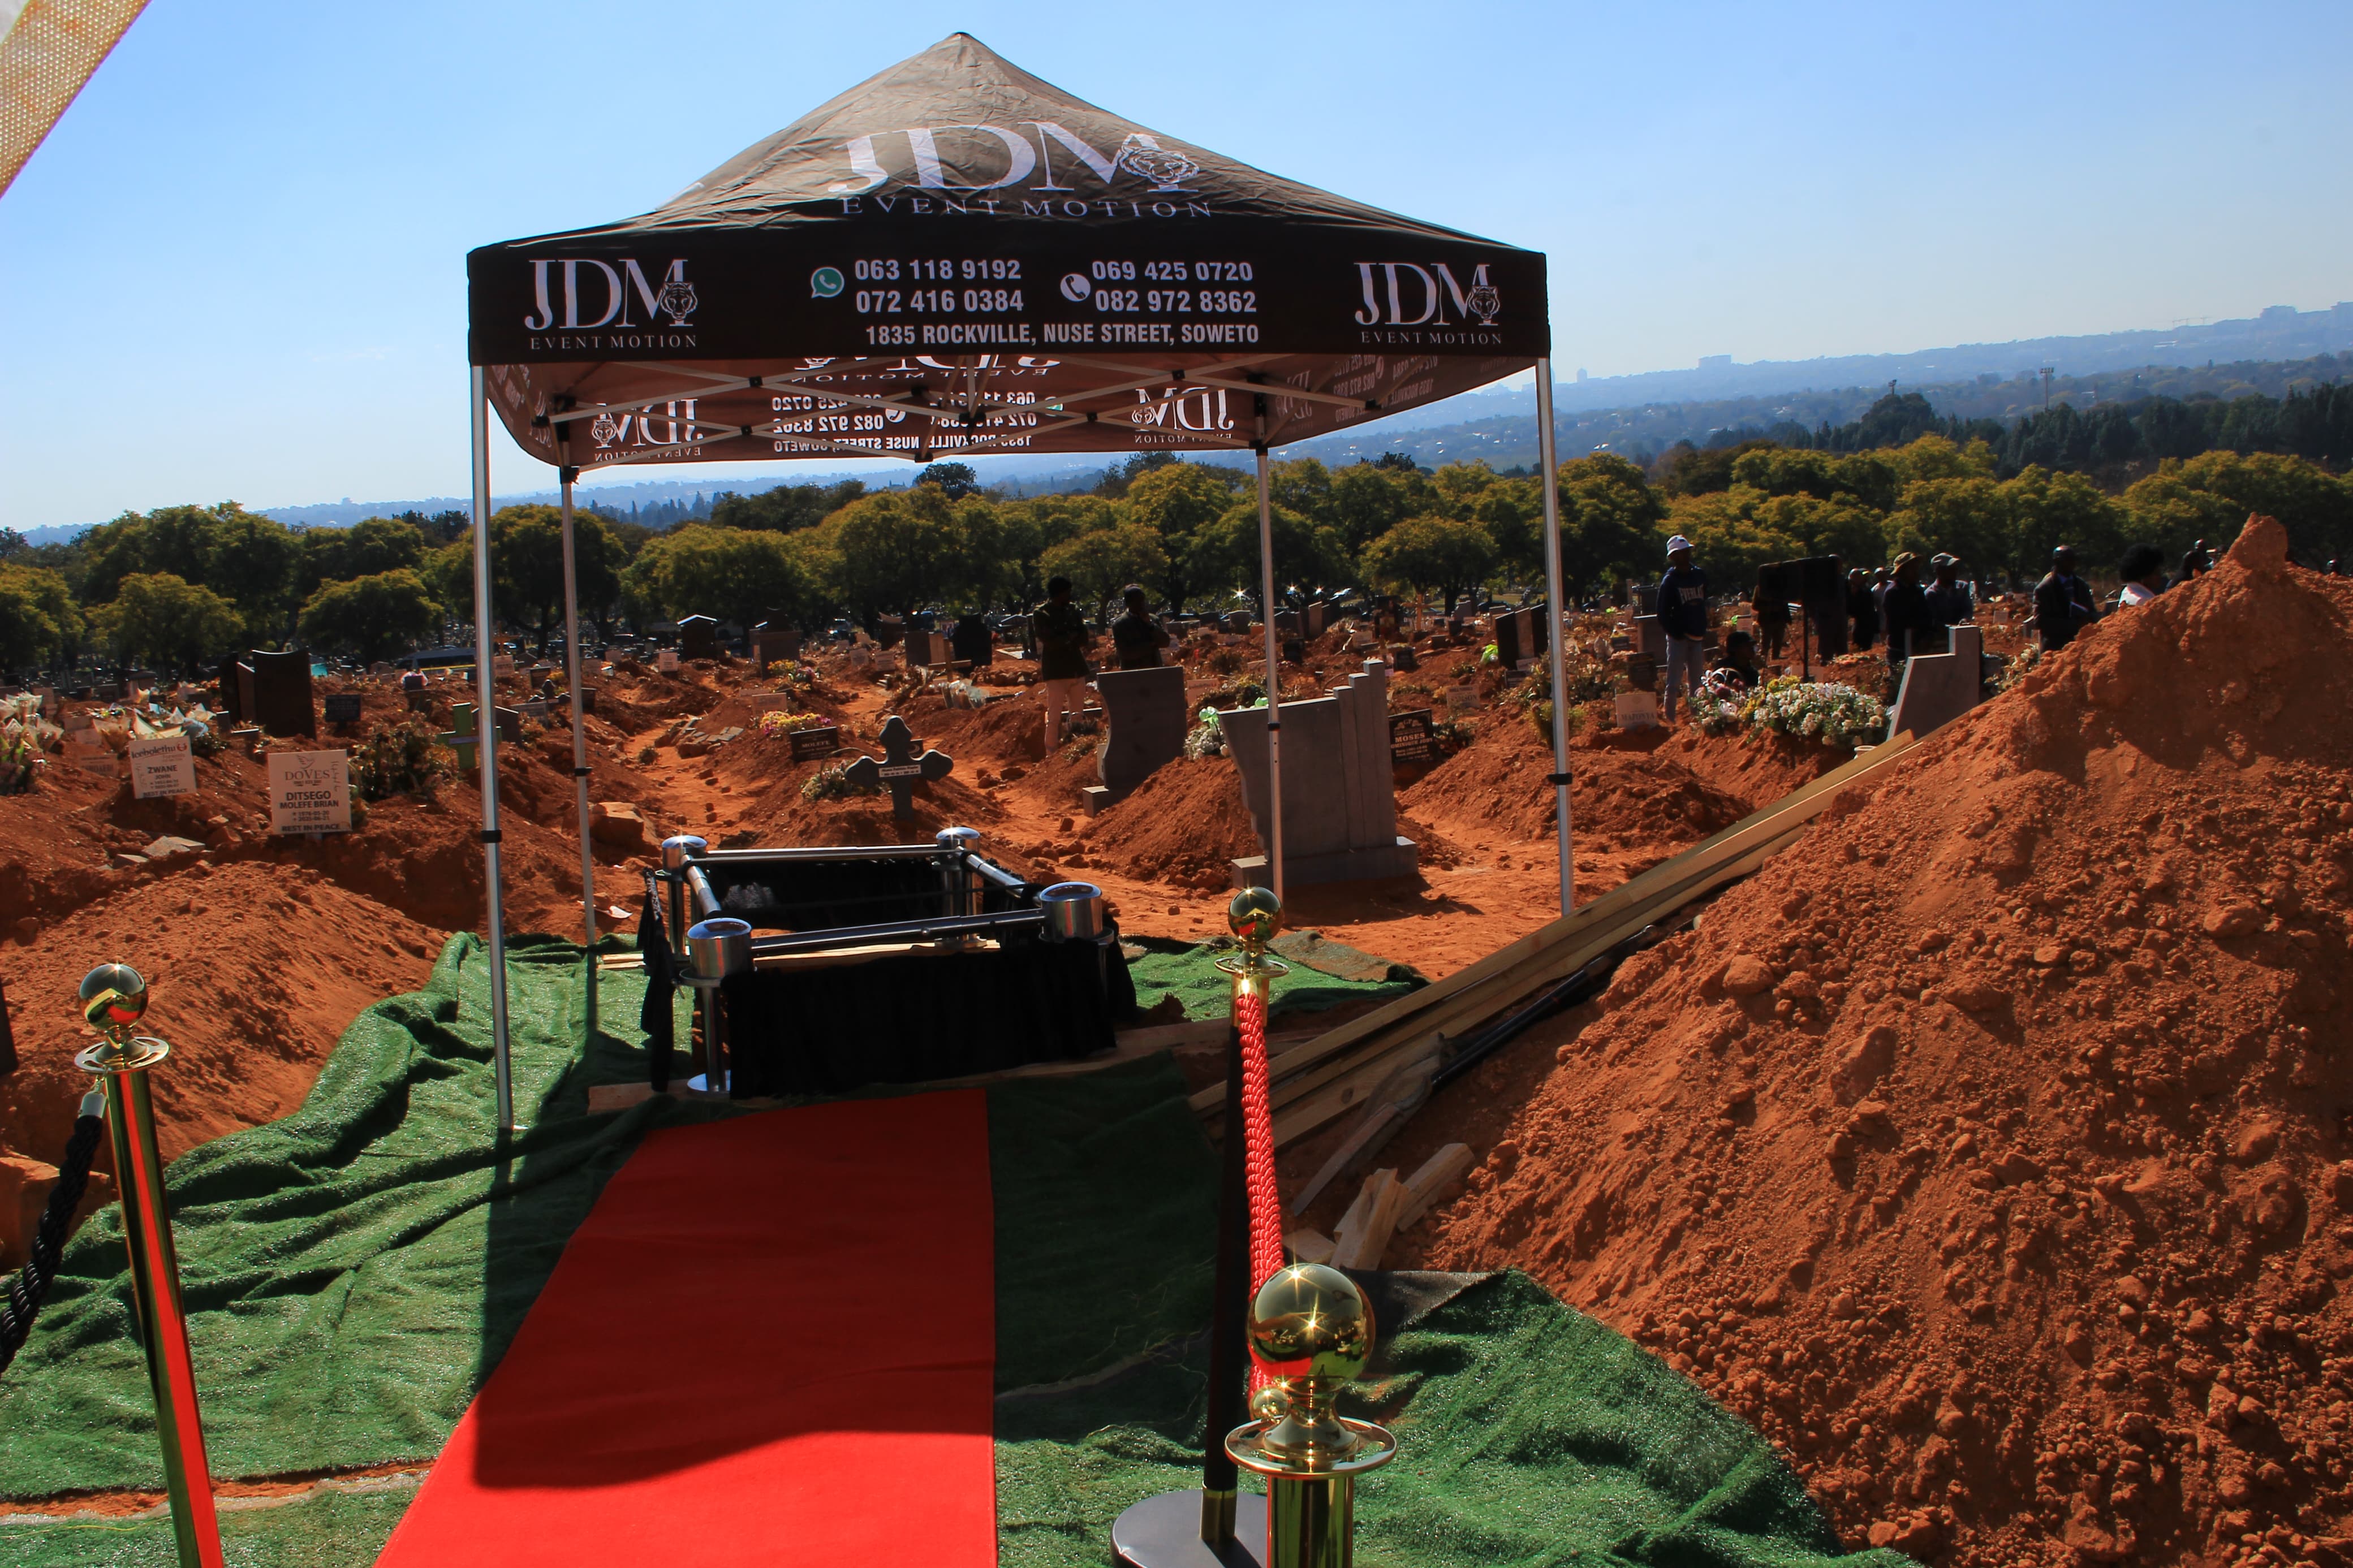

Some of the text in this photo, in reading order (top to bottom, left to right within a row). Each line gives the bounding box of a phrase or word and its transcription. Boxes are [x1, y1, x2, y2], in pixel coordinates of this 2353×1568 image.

[828, 121, 1199, 193] JDM
[841, 196, 1212, 218] EVENT MOTION
[855, 260, 1021, 280] 063 118 9192
[1092, 261, 1253, 281] 069 425 0720
[524, 258, 697, 330] JDM
[856, 290, 1024, 313] 072 416 0384
[1095, 290, 1257, 313] 082 972 8362
[1354, 262, 1500, 326] JDM
[530, 335, 697, 350] EVENT MOTION
[866, 323, 1259, 346] 1835 ROCKVILLE, NUSE STREET, SOWETO
[1360, 331, 1502, 344] EVENT MOTION
[1395, 732, 1425, 742] MOSES
[147, 764, 178, 774] ZWANE
[285, 769, 330, 780] DOVES
[280, 801, 313, 809] MOLEFE
[286, 791, 331, 801] DITSEGO
